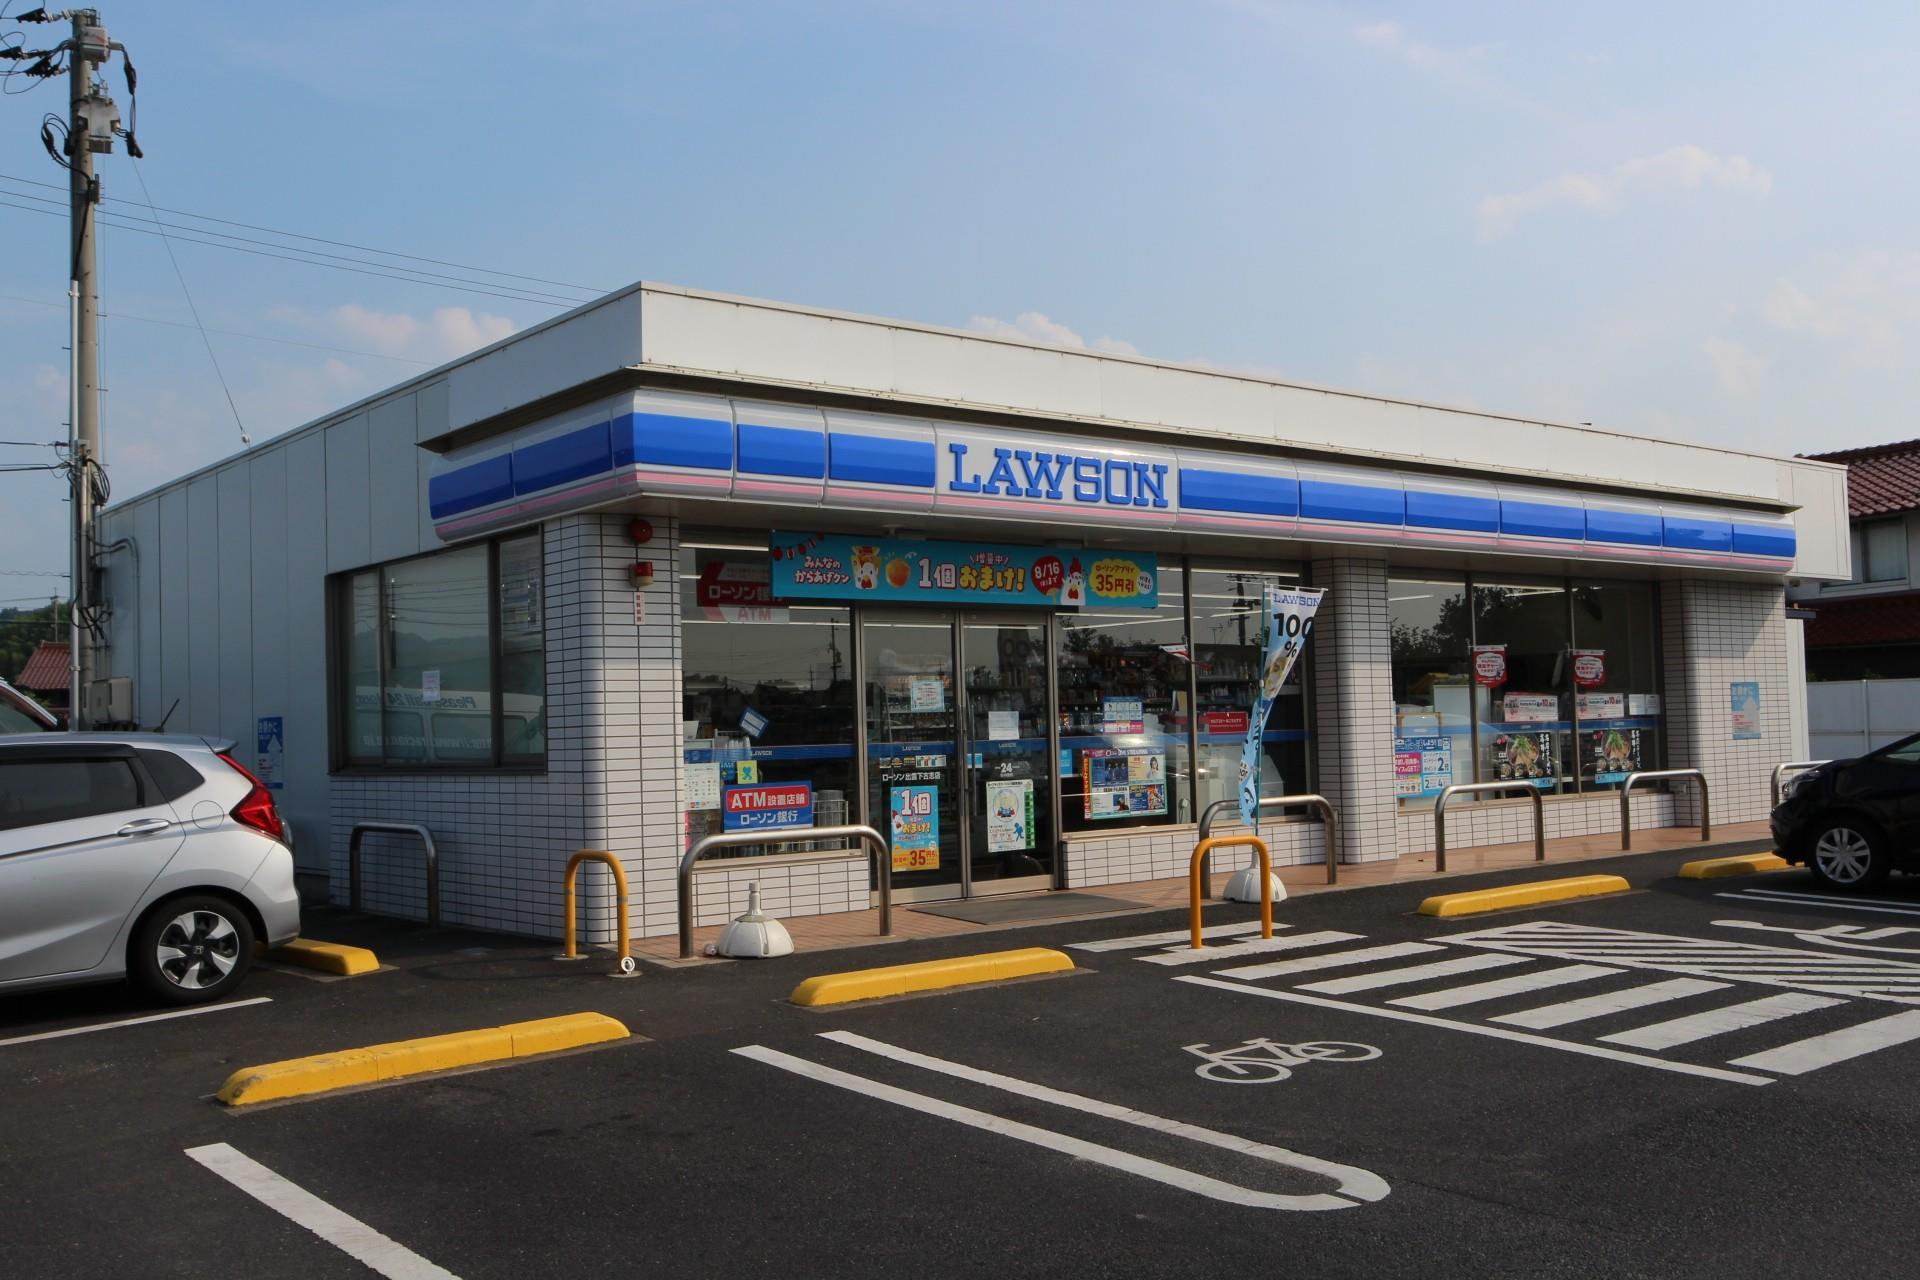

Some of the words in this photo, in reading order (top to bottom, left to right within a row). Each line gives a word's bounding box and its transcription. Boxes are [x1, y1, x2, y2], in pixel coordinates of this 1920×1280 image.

[949, 443, 1168, 508] LAWSON
[804, 555, 842, 569] みんなの
[794, 570, 850, 584] からあげクン
[1034, 561, 1060, 579] 8/16
[1096, 573, 1135, 593] 35円引
[1273, 593, 1320, 607] LAWSON
[736, 607, 770, 621] ATM
[740, 810, 799, 825] ローソン銀行
